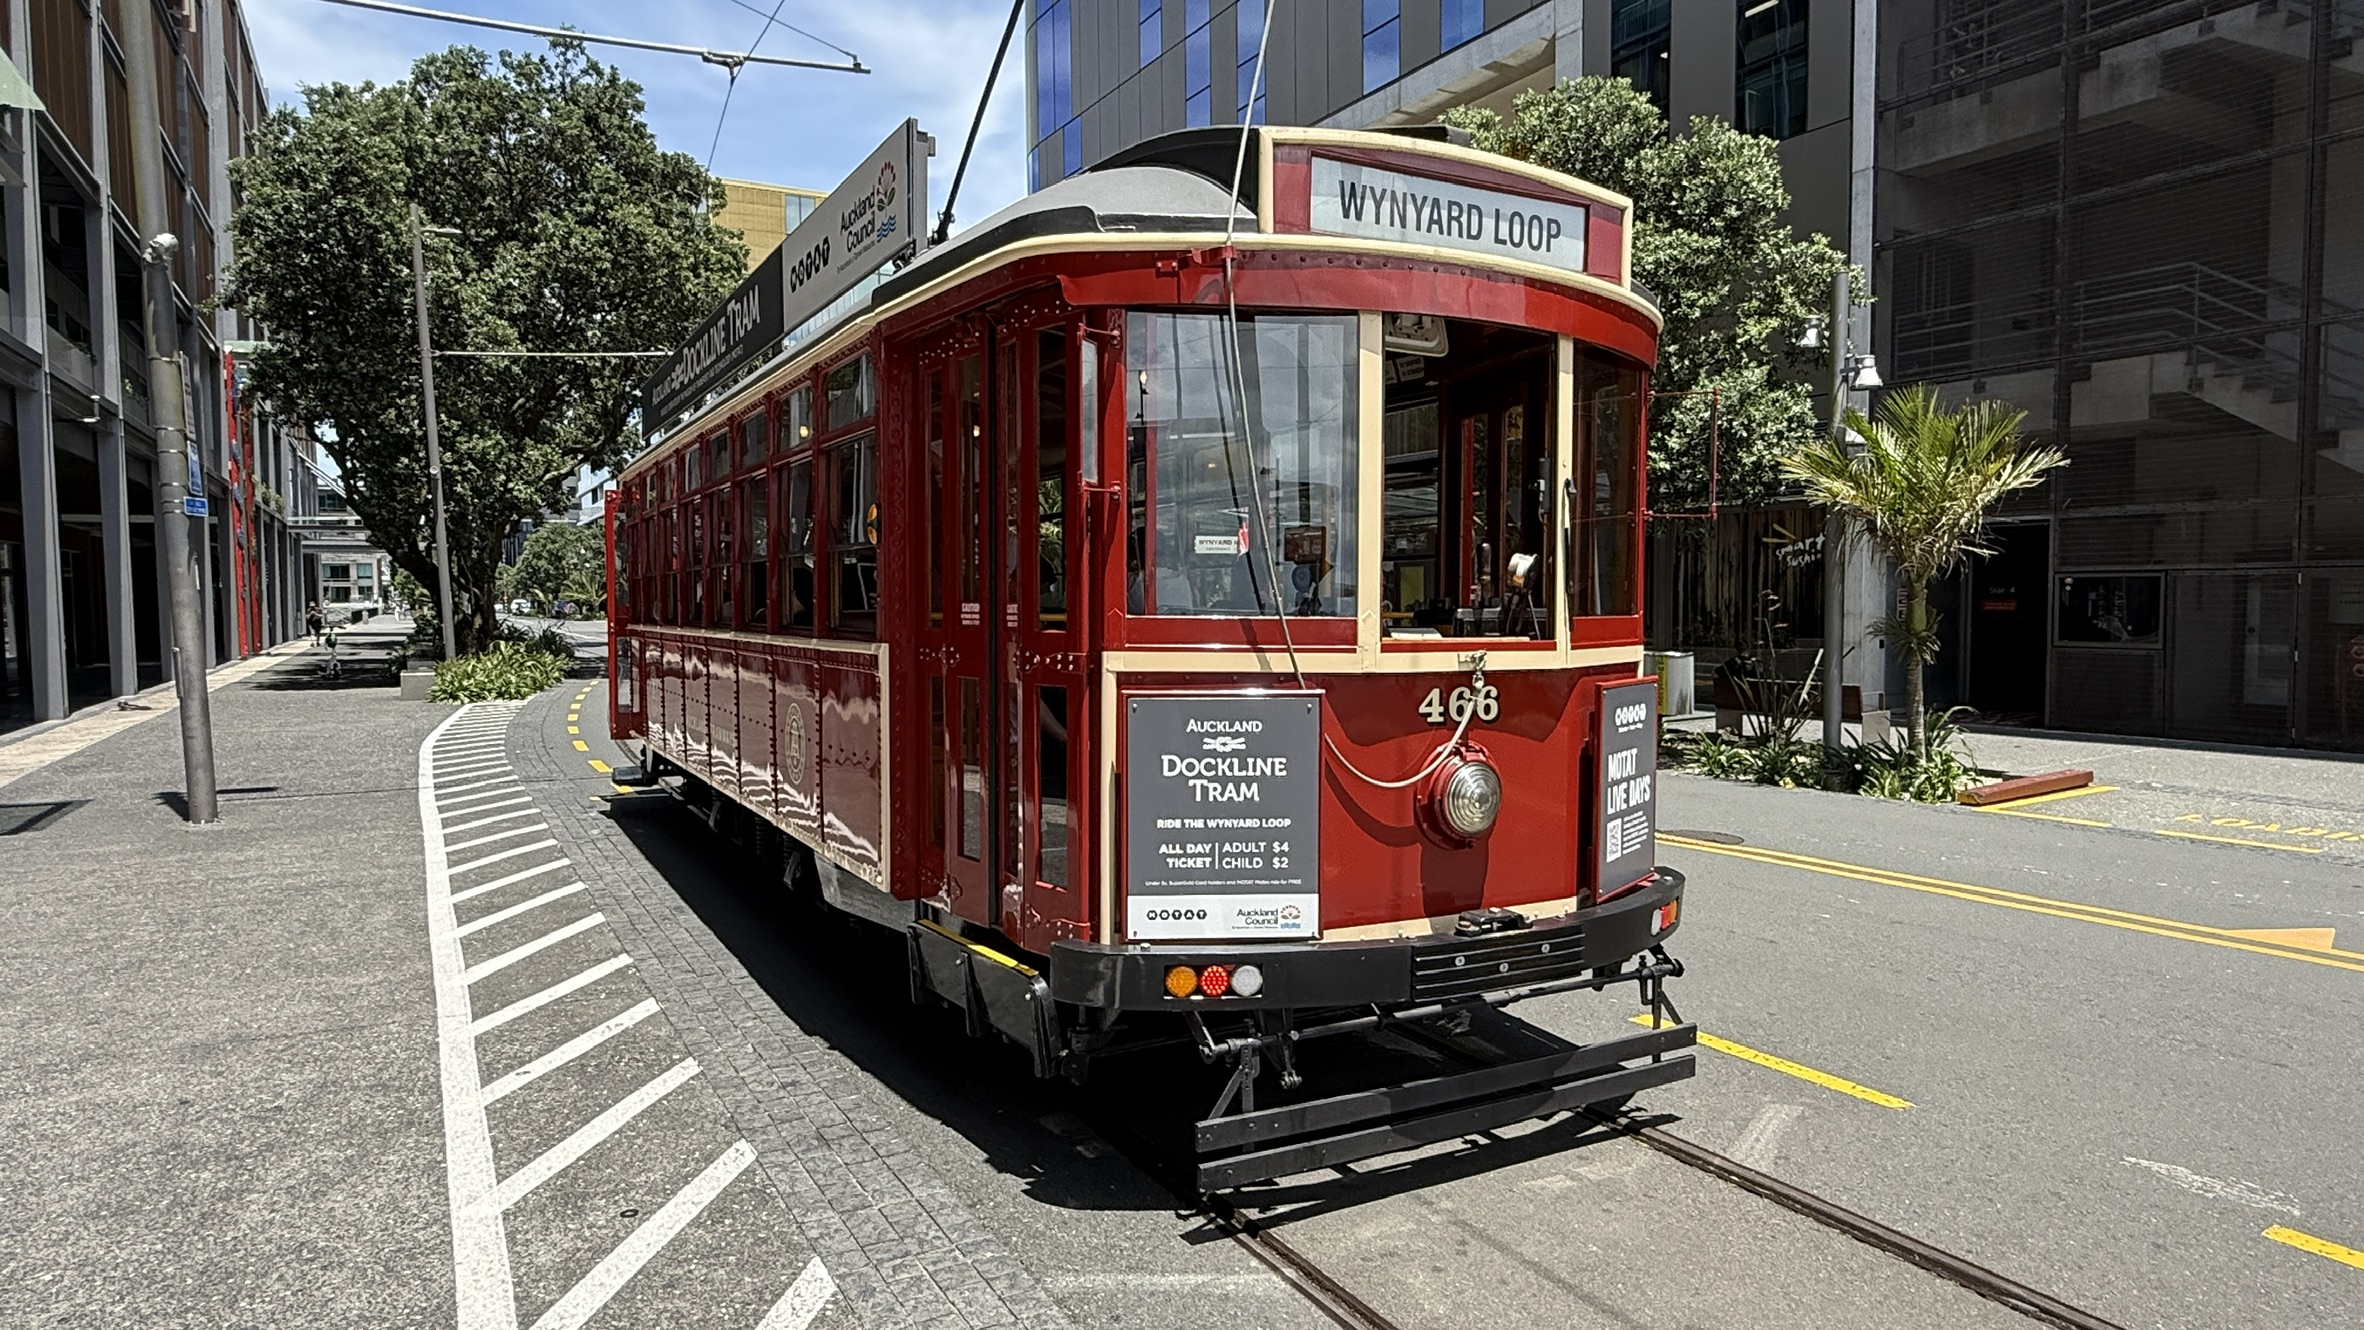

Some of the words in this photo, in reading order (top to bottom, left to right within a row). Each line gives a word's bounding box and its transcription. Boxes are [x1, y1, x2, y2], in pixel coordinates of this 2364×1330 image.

[840, 185, 875, 236] Auckland
[1338, 180, 1483, 241] WYNYARD
[1493, 207, 1562, 253] LOOP
[846, 211, 875, 253] Council
[683, 316, 726, 385] DOCKLINE
[727, 285, 760, 345] TRAM
[1776, 532, 1825, 560] smart
[1786, 548, 1815, 567] sushi
[1419, 685, 1498, 722] 466
[1186, 719, 1263, 733] AUCKLAND
[1161, 755, 1287, 777] DOCKLINE
[1608, 748, 1637, 782] MOTAT
[1188, 779, 1260, 802] TRAM
[1607, 783, 1627, 815] LIVE
[1629, 775, 1651, 810] DAYS
[1156, 818, 1181, 829] RIDE
[1183, 818, 1204, 829] THE
[1206, 818, 1260, 829] WYNYARD
[1262, 818, 1292, 828] LOOP
[1159, 843, 1184, 854] ALL
[1186, 843, 1212, 854] DAY
[1222, 842, 1266, 853] ADULT
[1272, 841, 1290, 853] $4
[1166, 857, 1212, 869] TICKET
[1222, 857, 1263, 869] CHILD
[1272, 857, 1289, 869] $2
[1147, 909, 1207, 920] MOTAT
[1237, 908, 1278, 917] Auckland
[1245, 917, 1278, 925] Council
